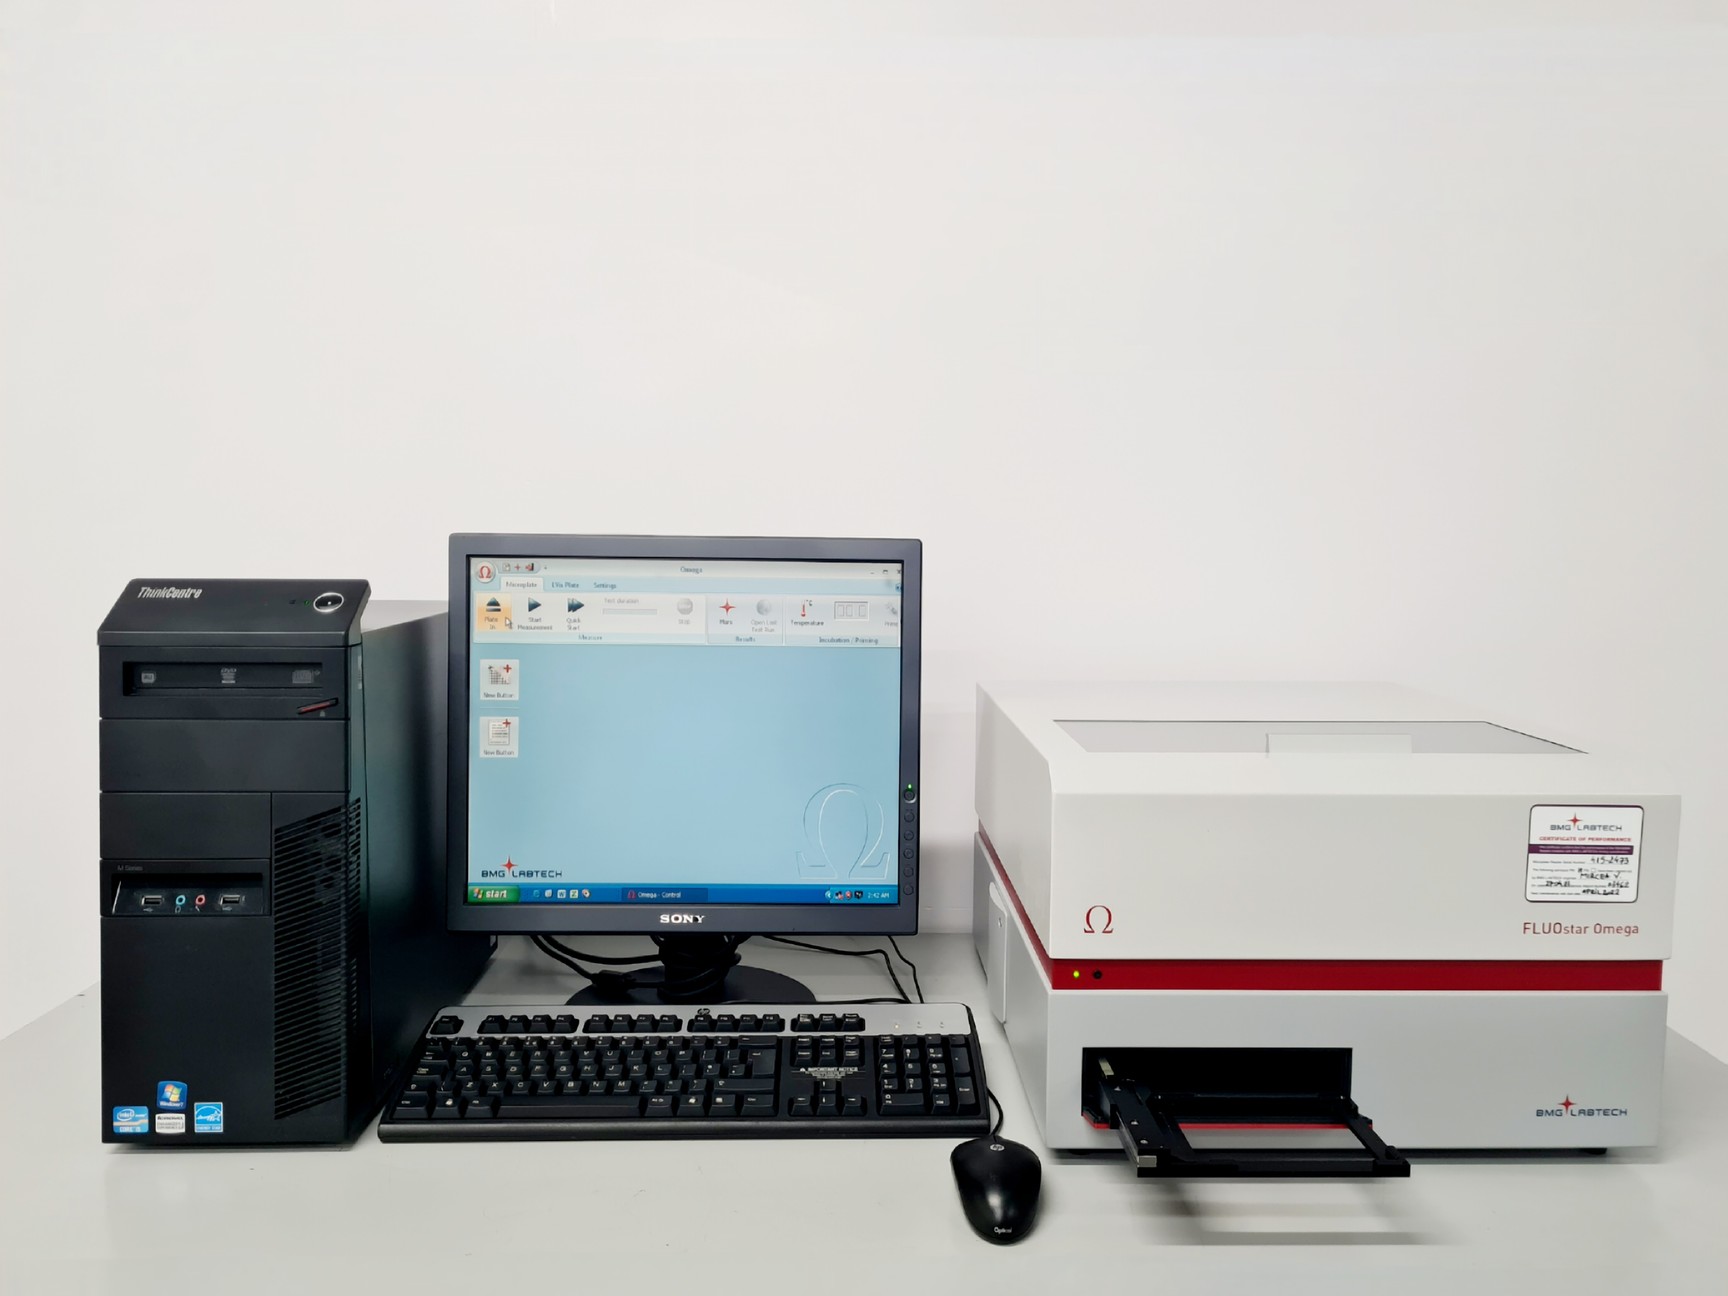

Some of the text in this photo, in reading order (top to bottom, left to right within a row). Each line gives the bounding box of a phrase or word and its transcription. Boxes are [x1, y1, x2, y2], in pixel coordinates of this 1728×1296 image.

[593, 582, 617, 590] Settings
[137, 587, 203, 599] ThinkCentre
[481, 870, 562, 878] BMG LABTECH
[486, 889, 508, 899] start
[638, 891, 658, 900] Omega
[660, 914, 706, 924] SONY
[1522, 922, 1639, 937] FLUOstar Omega
[1536, 1108, 1628, 1117] BMG LABTECH
